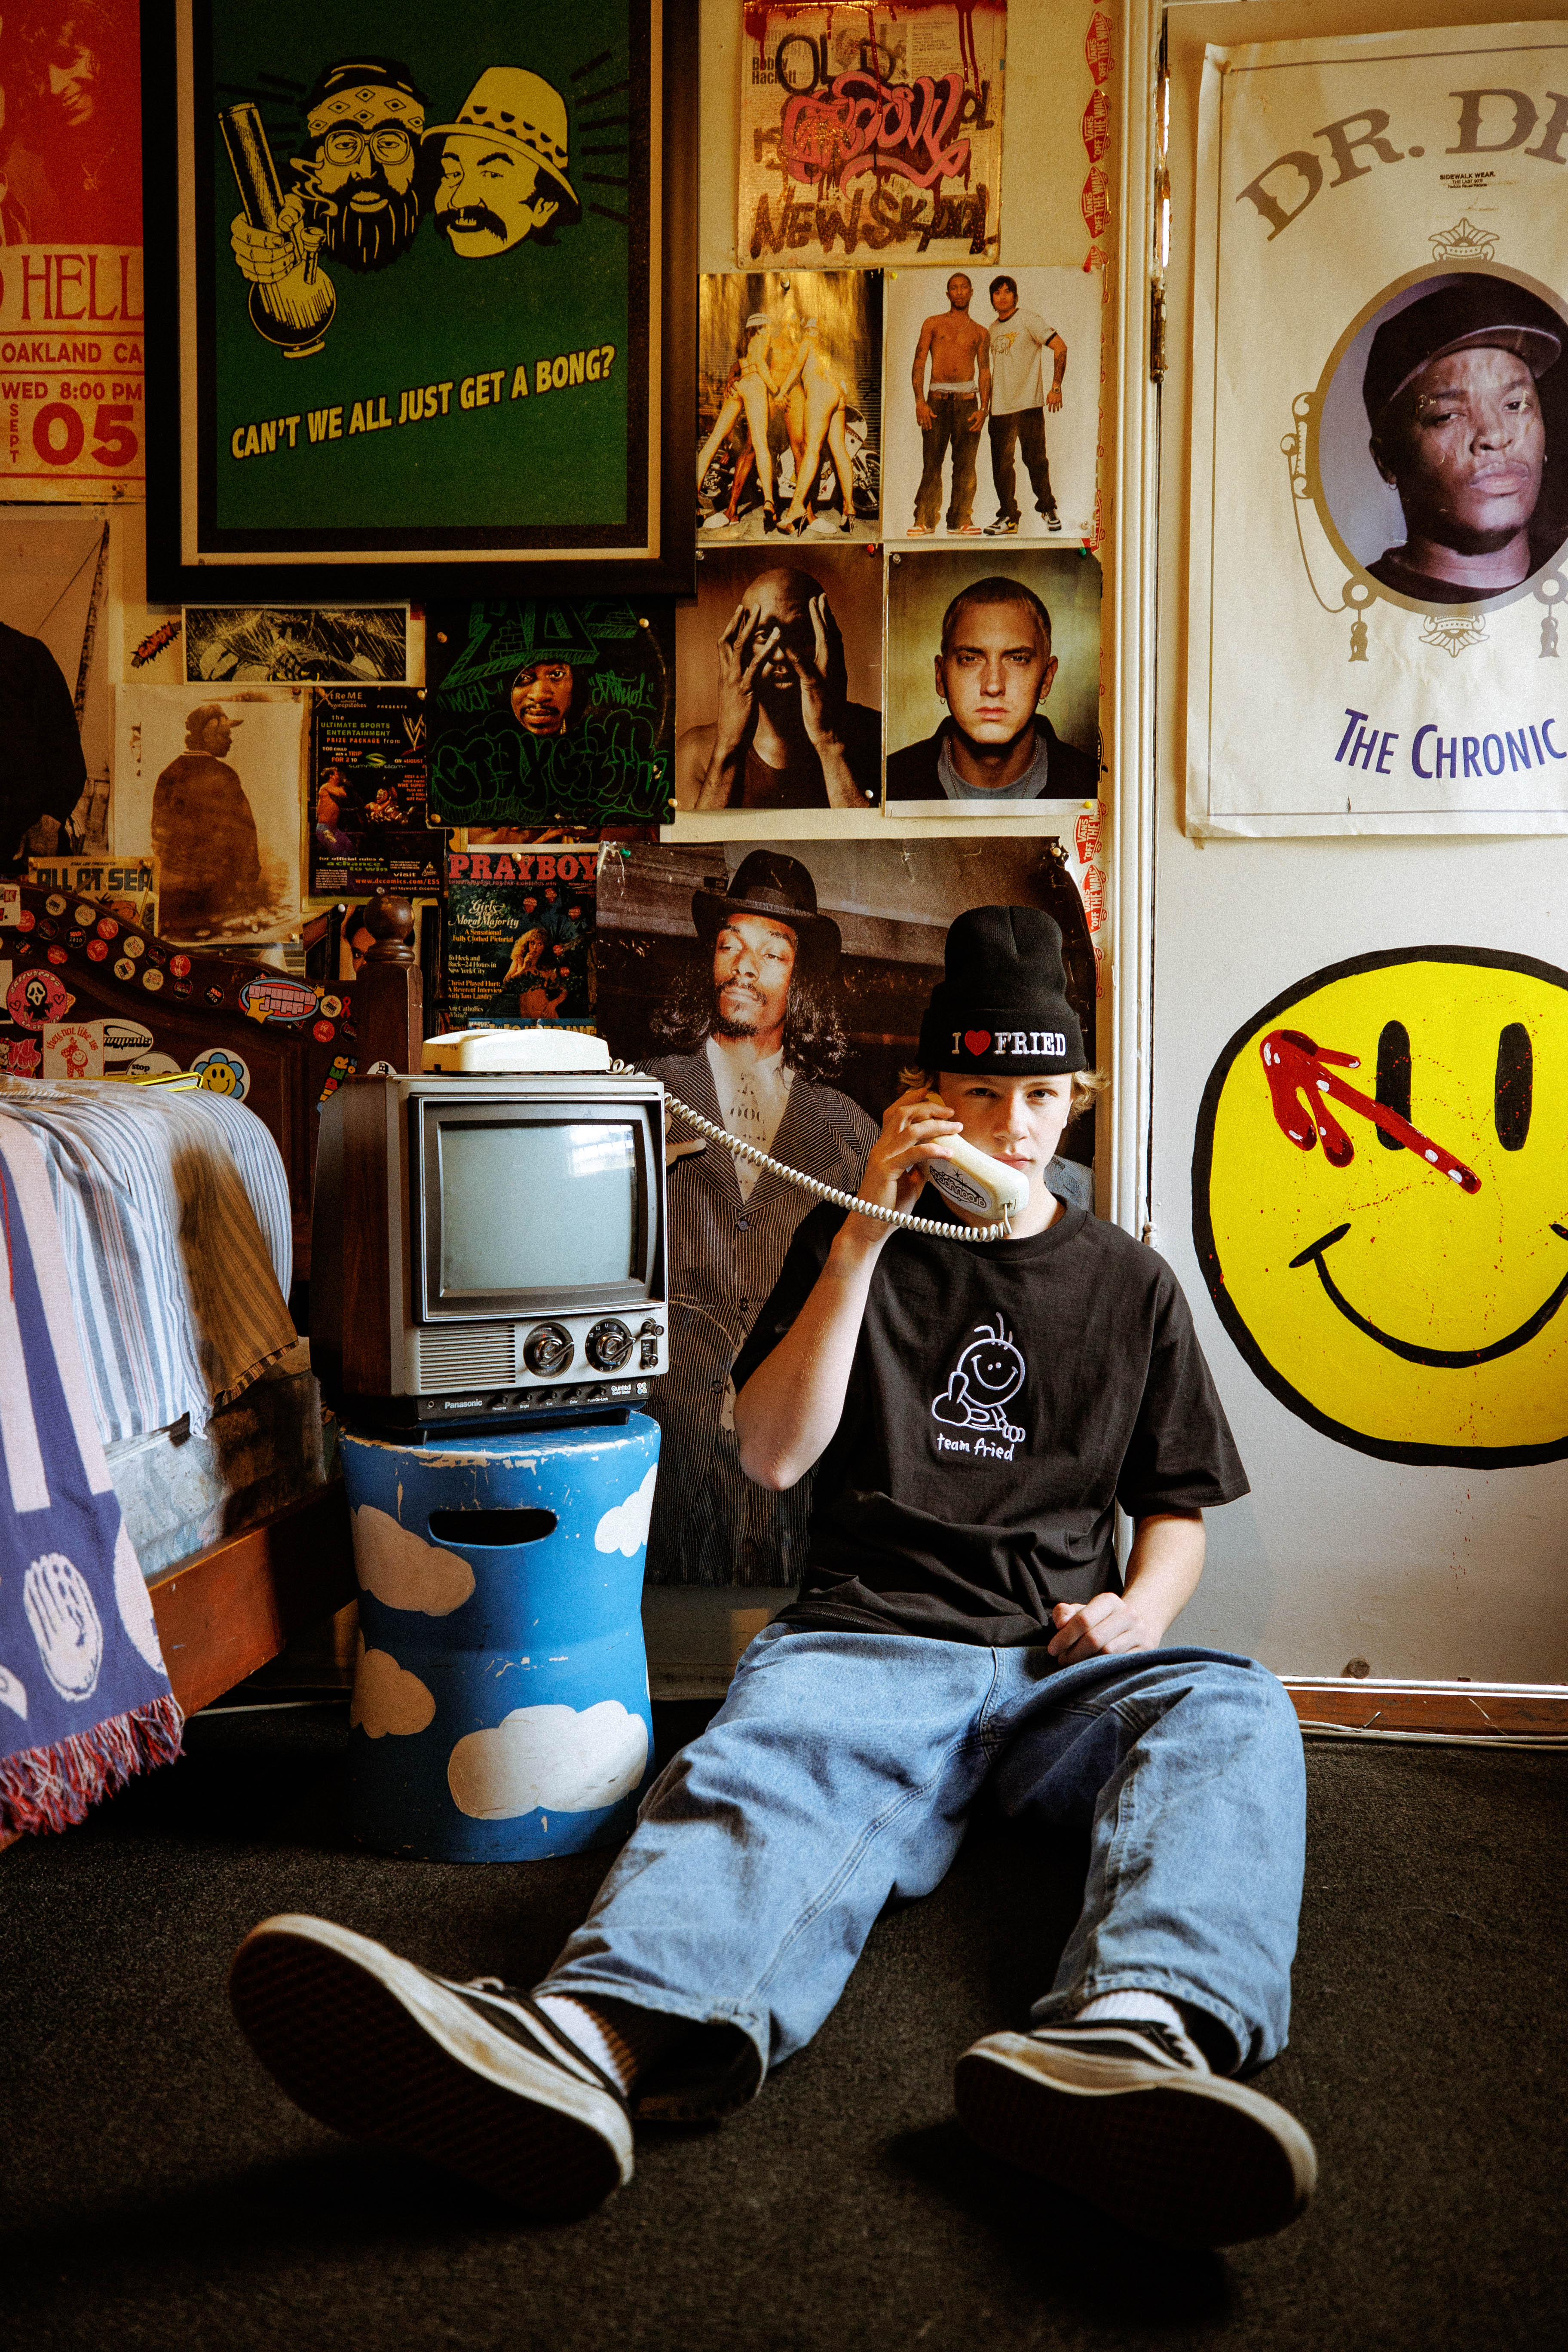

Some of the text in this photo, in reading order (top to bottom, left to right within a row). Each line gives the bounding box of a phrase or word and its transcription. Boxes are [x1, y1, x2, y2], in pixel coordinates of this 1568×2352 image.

[1097, 40, 1109, 60] THE
[1094, 119, 1106, 138] THE
[1236, 108, 1425, 242] DR.
[1093, 195, 1105, 213] THE
[1, 342, 142, 364] OAKLAND CA
[1, 381, 142, 401] WED 8:00 PM
[232, 345, 616, 459] CAN'T WE ALL JUST GET A BONG?
[9, 404, 19, 463] SEPT
[32, 401, 138, 467] 05
[1335, 708, 1568, 779] THE CHRONIC
[1077, 818, 1088, 843] VANS
[1087, 824, 1101, 841] THE
[449, 854, 598, 880] PRAYBOY
[108, 868, 153, 891] SEA
[469, 899, 505, 914] Girls
[1090, 891, 1102, 910] THE
[448, 915, 519, 928] Moral Majority
[47, 1026, 98, 1050] they not like us
[952, 1032, 1066, 1056] I FRIED
[132, 1064, 150, 1072] stop
[929, 1165, 987, 1208] groovypads
[444, 1399, 483, 1409] Panasonic
[937, 1433, 1014, 1461] team fried
